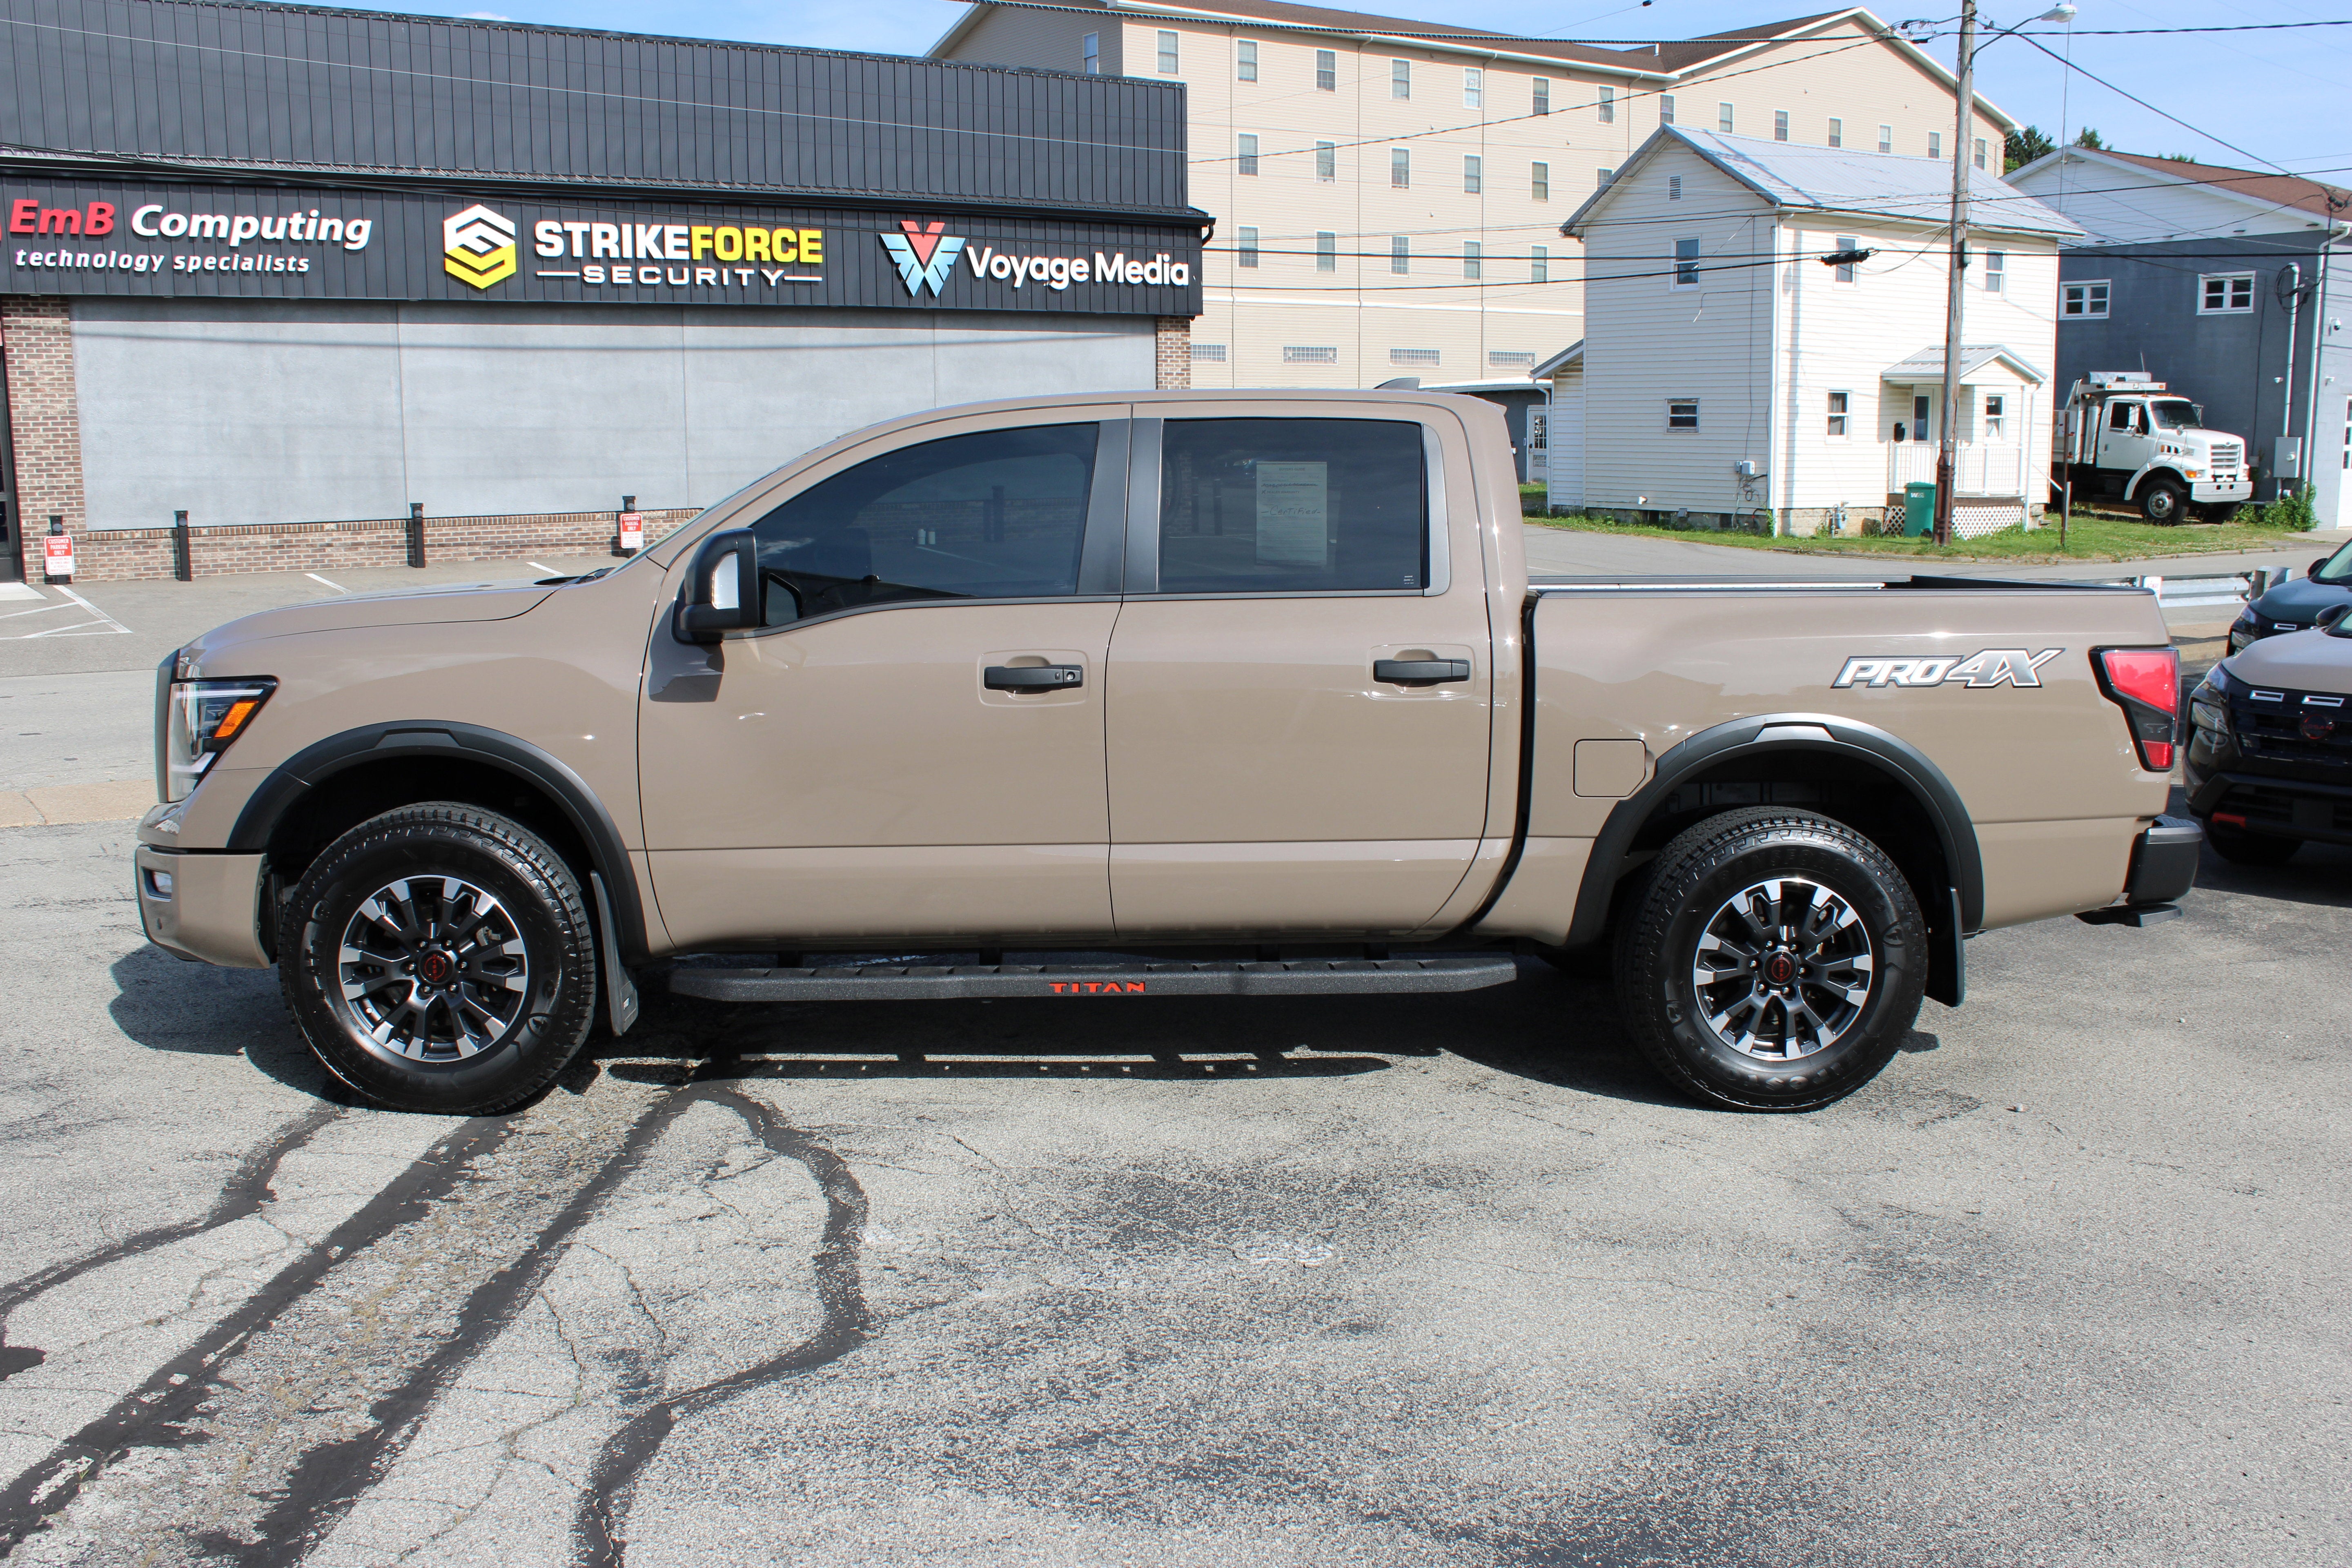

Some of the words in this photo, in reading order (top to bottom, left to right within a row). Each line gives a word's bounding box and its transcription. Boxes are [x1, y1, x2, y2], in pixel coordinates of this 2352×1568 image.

[9, 199, 115, 235] EmB
[131, 205, 372, 250] Computing
[535, 220, 823, 263] STRIKEFORCE
[15, 249, 165, 272] technology
[173, 253, 310, 273] specialists
[583, 265, 784, 286] SECURITY
[966, 246, 1089, 290] Voyage
[1095, 252, 1189, 286] Media
[1049, 982, 1145, 993] TITAN
